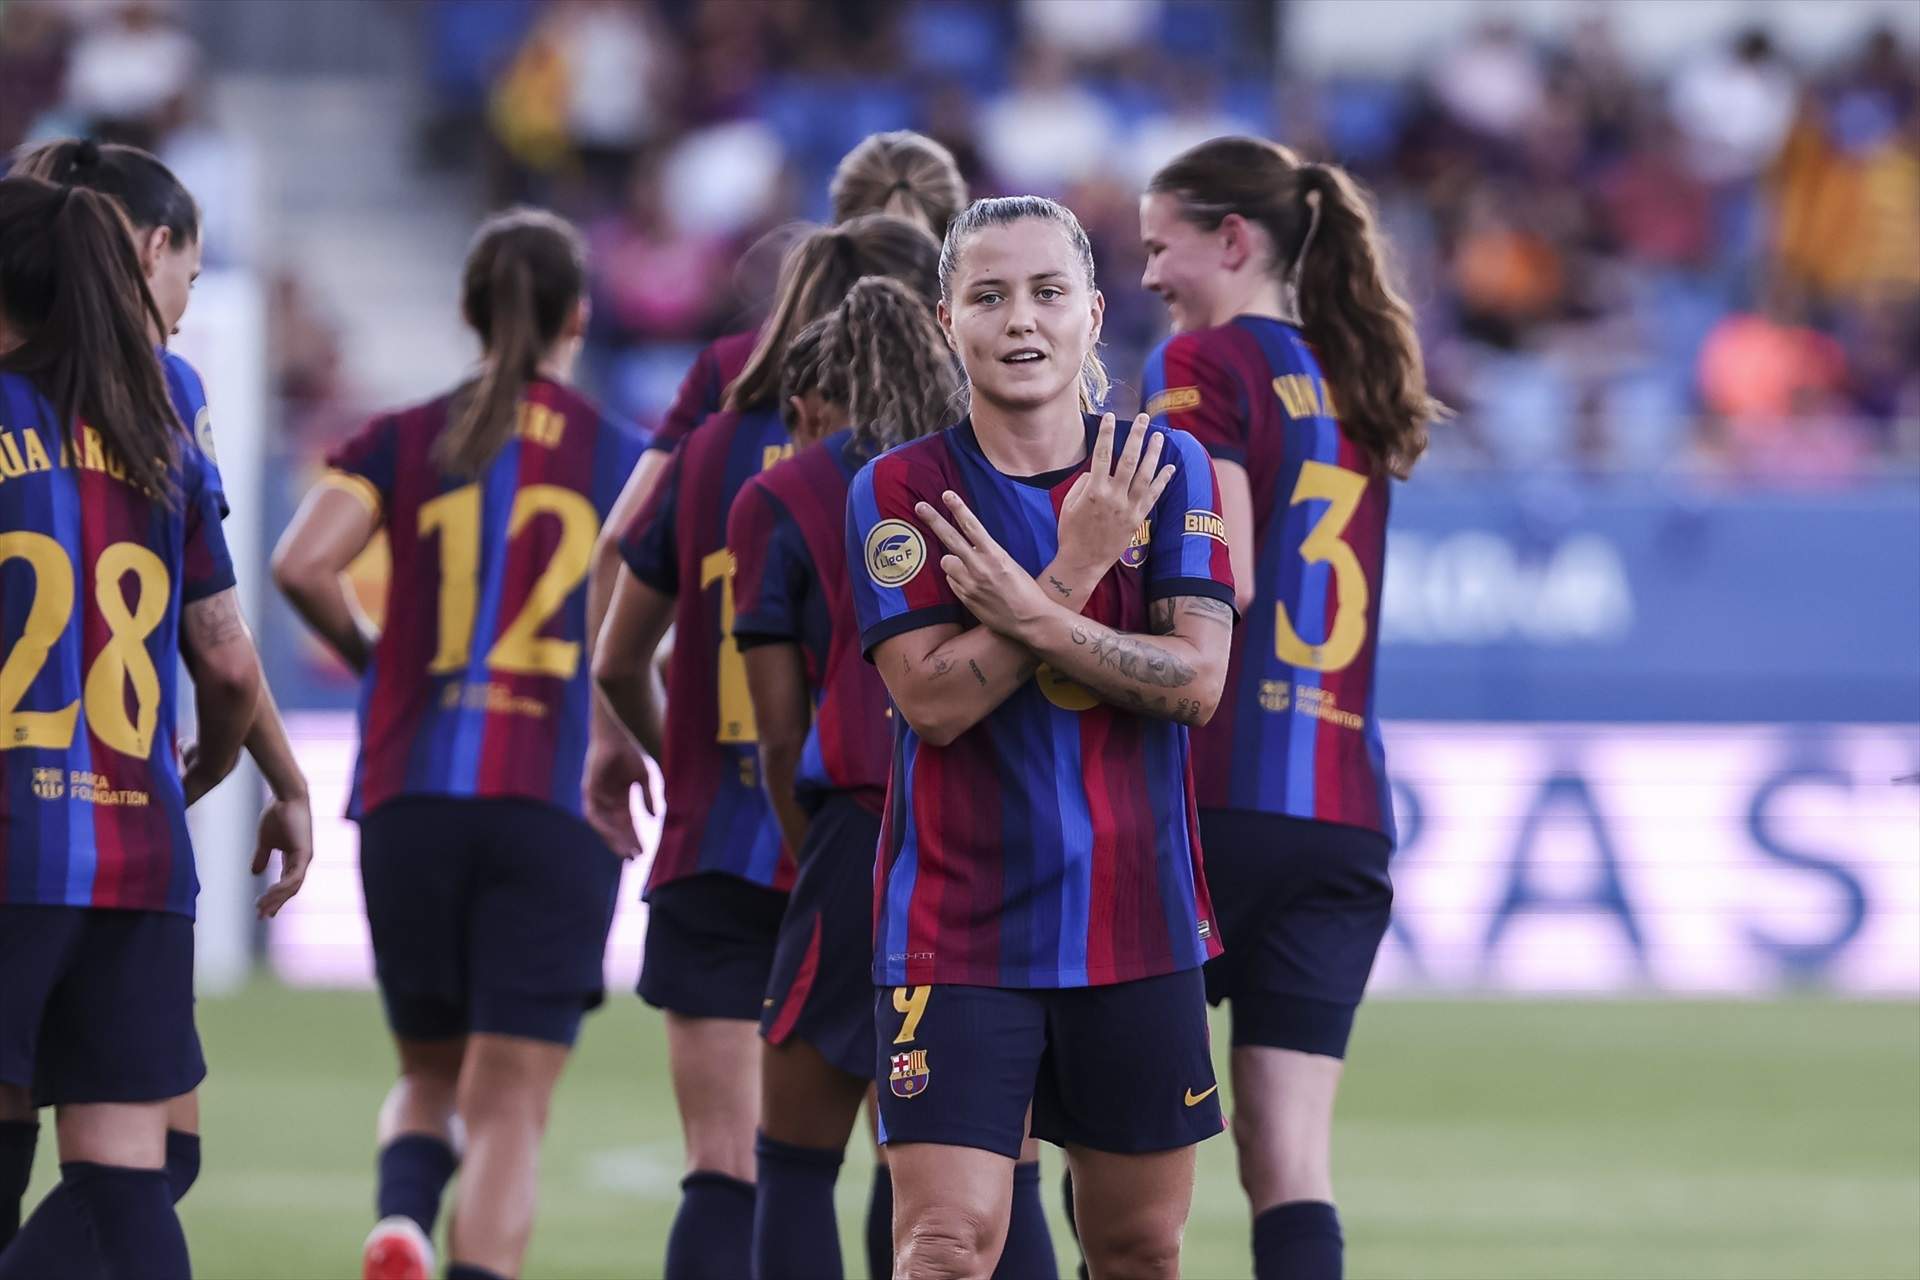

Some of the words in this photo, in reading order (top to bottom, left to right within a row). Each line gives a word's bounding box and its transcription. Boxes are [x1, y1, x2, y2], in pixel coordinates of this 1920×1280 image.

[418, 483, 599, 681] 12
[880, 553, 903, 568] Liga
[905, 549, 912, 560] F
[1184, 514, 1227, 541] BIMB
[1276, 460, 1368, 673] 3
[0, 531, 171, 760] 28
[893, 985, 931, 1044] 9
